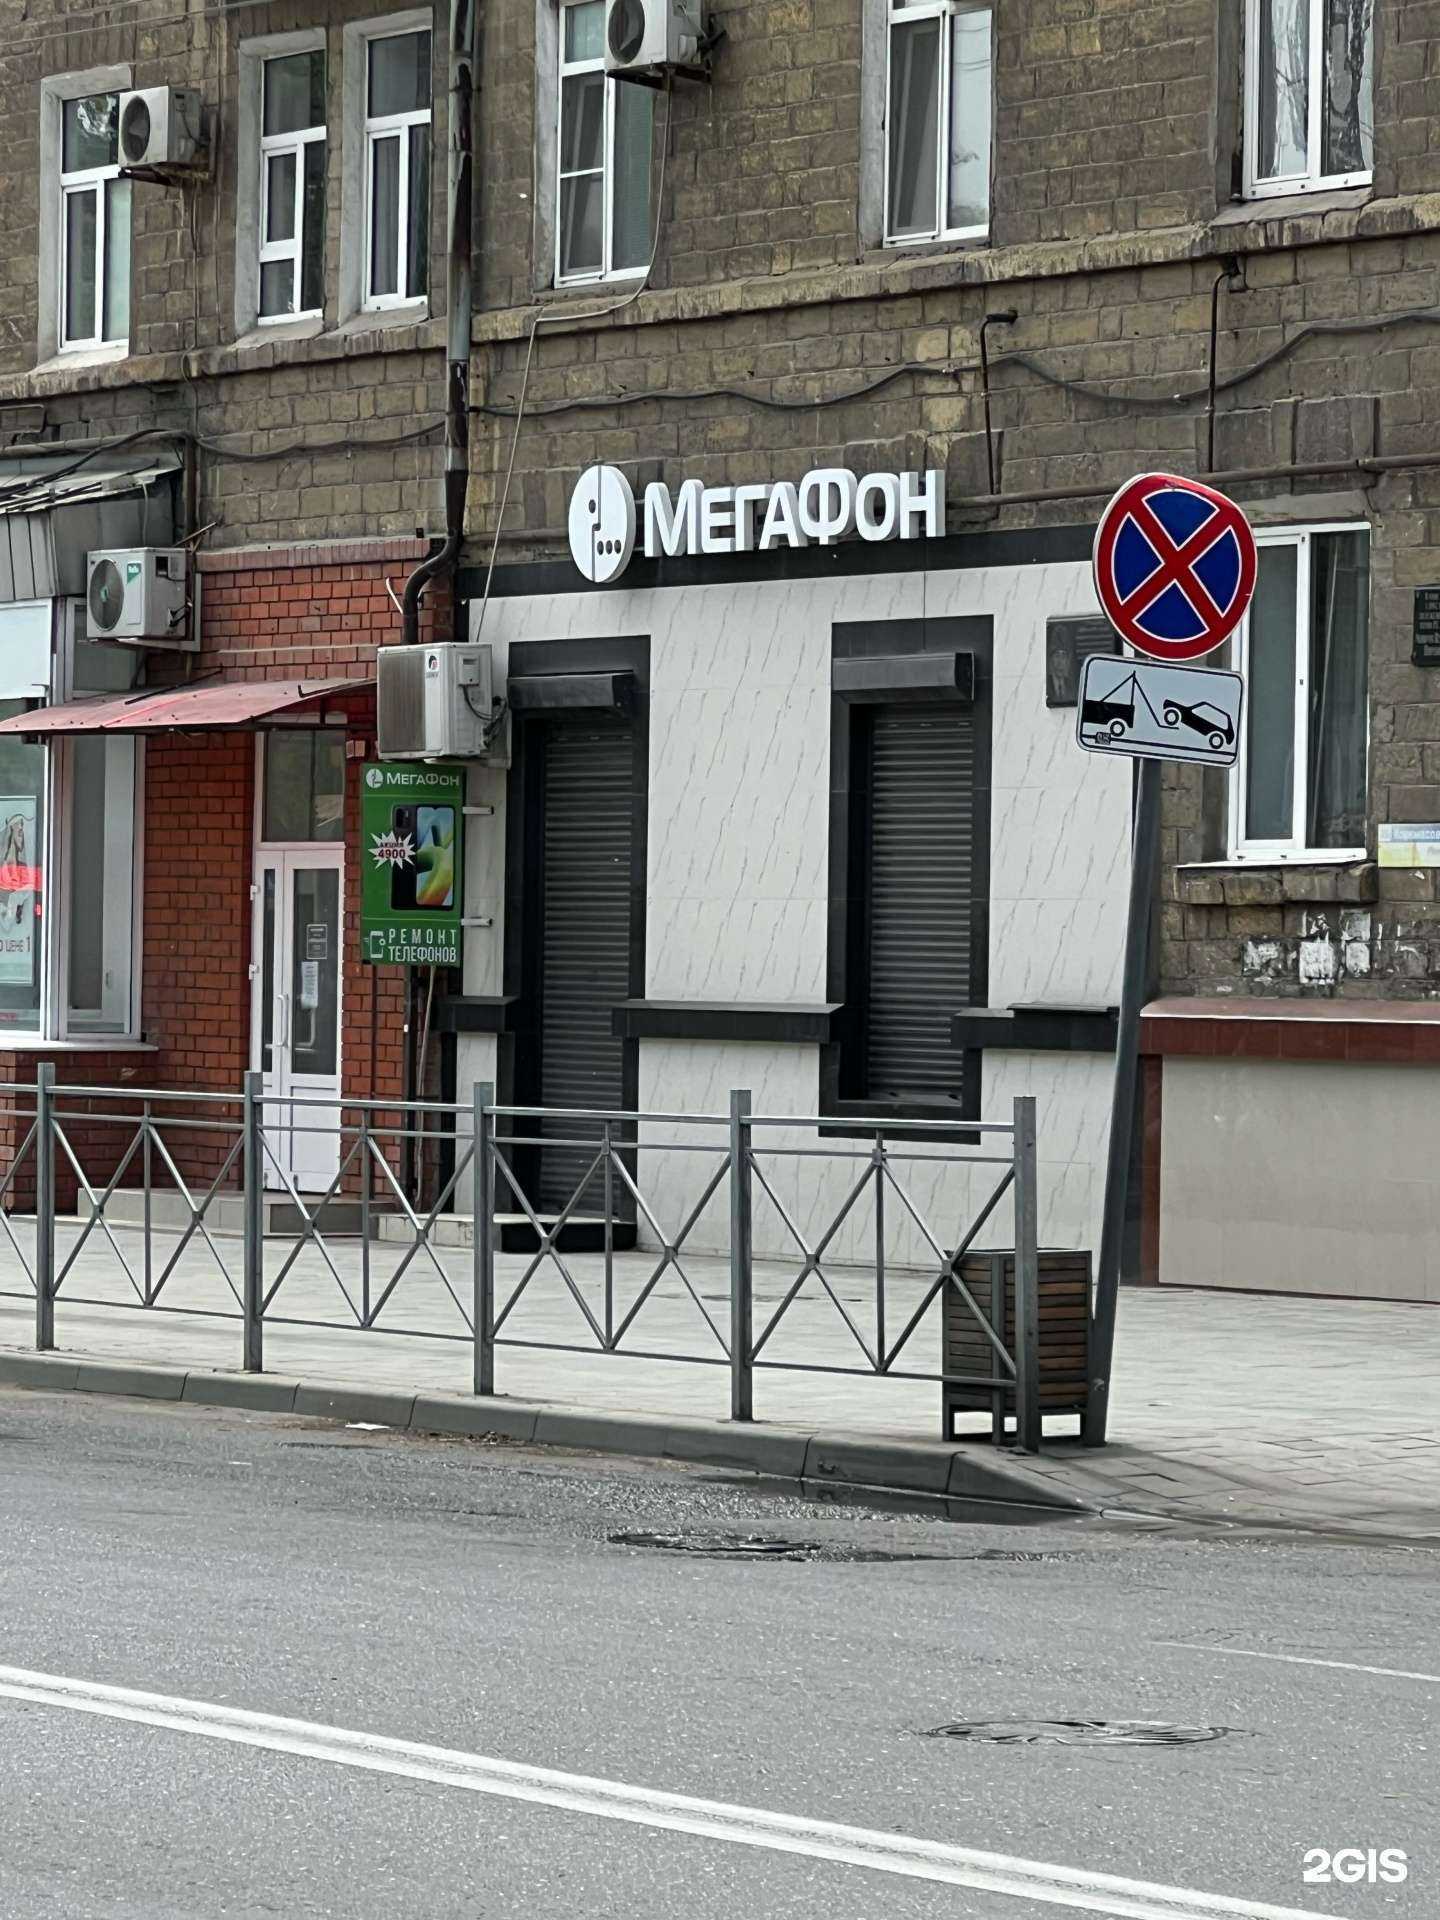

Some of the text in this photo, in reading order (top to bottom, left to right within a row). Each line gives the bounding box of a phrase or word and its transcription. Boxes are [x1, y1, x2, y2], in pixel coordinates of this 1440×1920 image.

[643, 468, 946, 558] МЕГАФОН
[386, 772, 460, 786] МЕГАФОН
[378, 849, 406, 859] 4900
[388, 928, 457, 945] РЕМОНТ
[388, 945, 457, 963] ТЕЛЕФОНОВ
